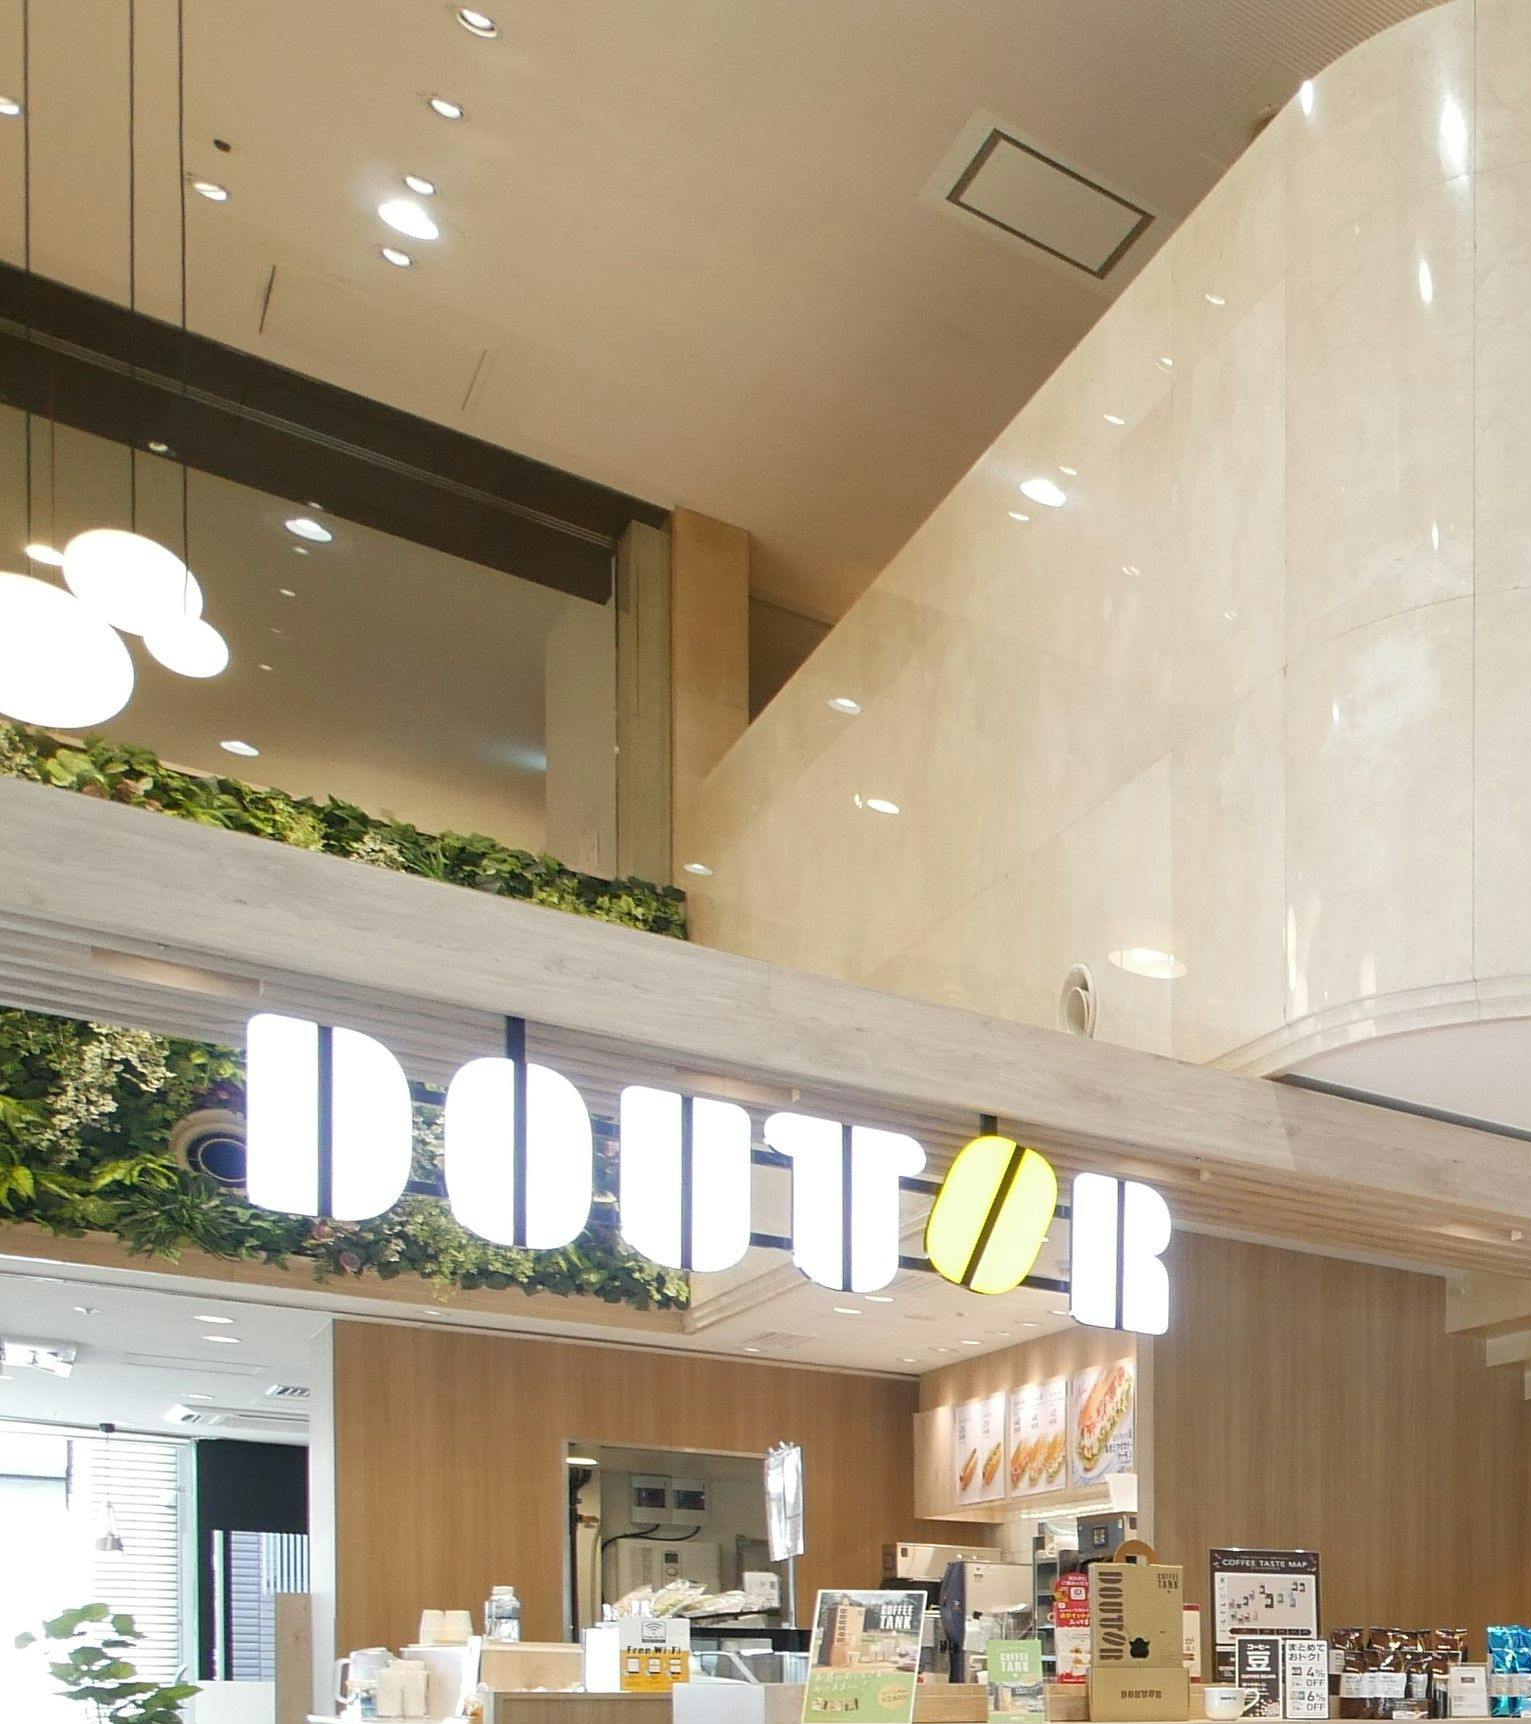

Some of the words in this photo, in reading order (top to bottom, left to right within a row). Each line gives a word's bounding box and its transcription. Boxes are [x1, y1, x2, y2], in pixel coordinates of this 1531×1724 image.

[246, 1012, 1171, 1335] DOUTOR
[1222, 1559, 1257, 1567] COFFEE
[1259, 1560, 1286, 1568] TASTE
[1158, 1580, 1179, 1590] TANK
[881, 1604, 914, 1616] COFFEE
[1098, 1571, 1126, 1660] DOUTOR
[880, 1615, 912, 1630] TANK
[1289, 1643, 1325, 1652] まとめて
[1000, 1653, 1028, 1661] COFFEE
[1246, 1651, 1271, 1671] 豆
[1001, 1661, 1029, 1672] TANK
[1306, 1679, 1325, 1687] OFF
[1306, 1703, 1325, 1711] OFF
